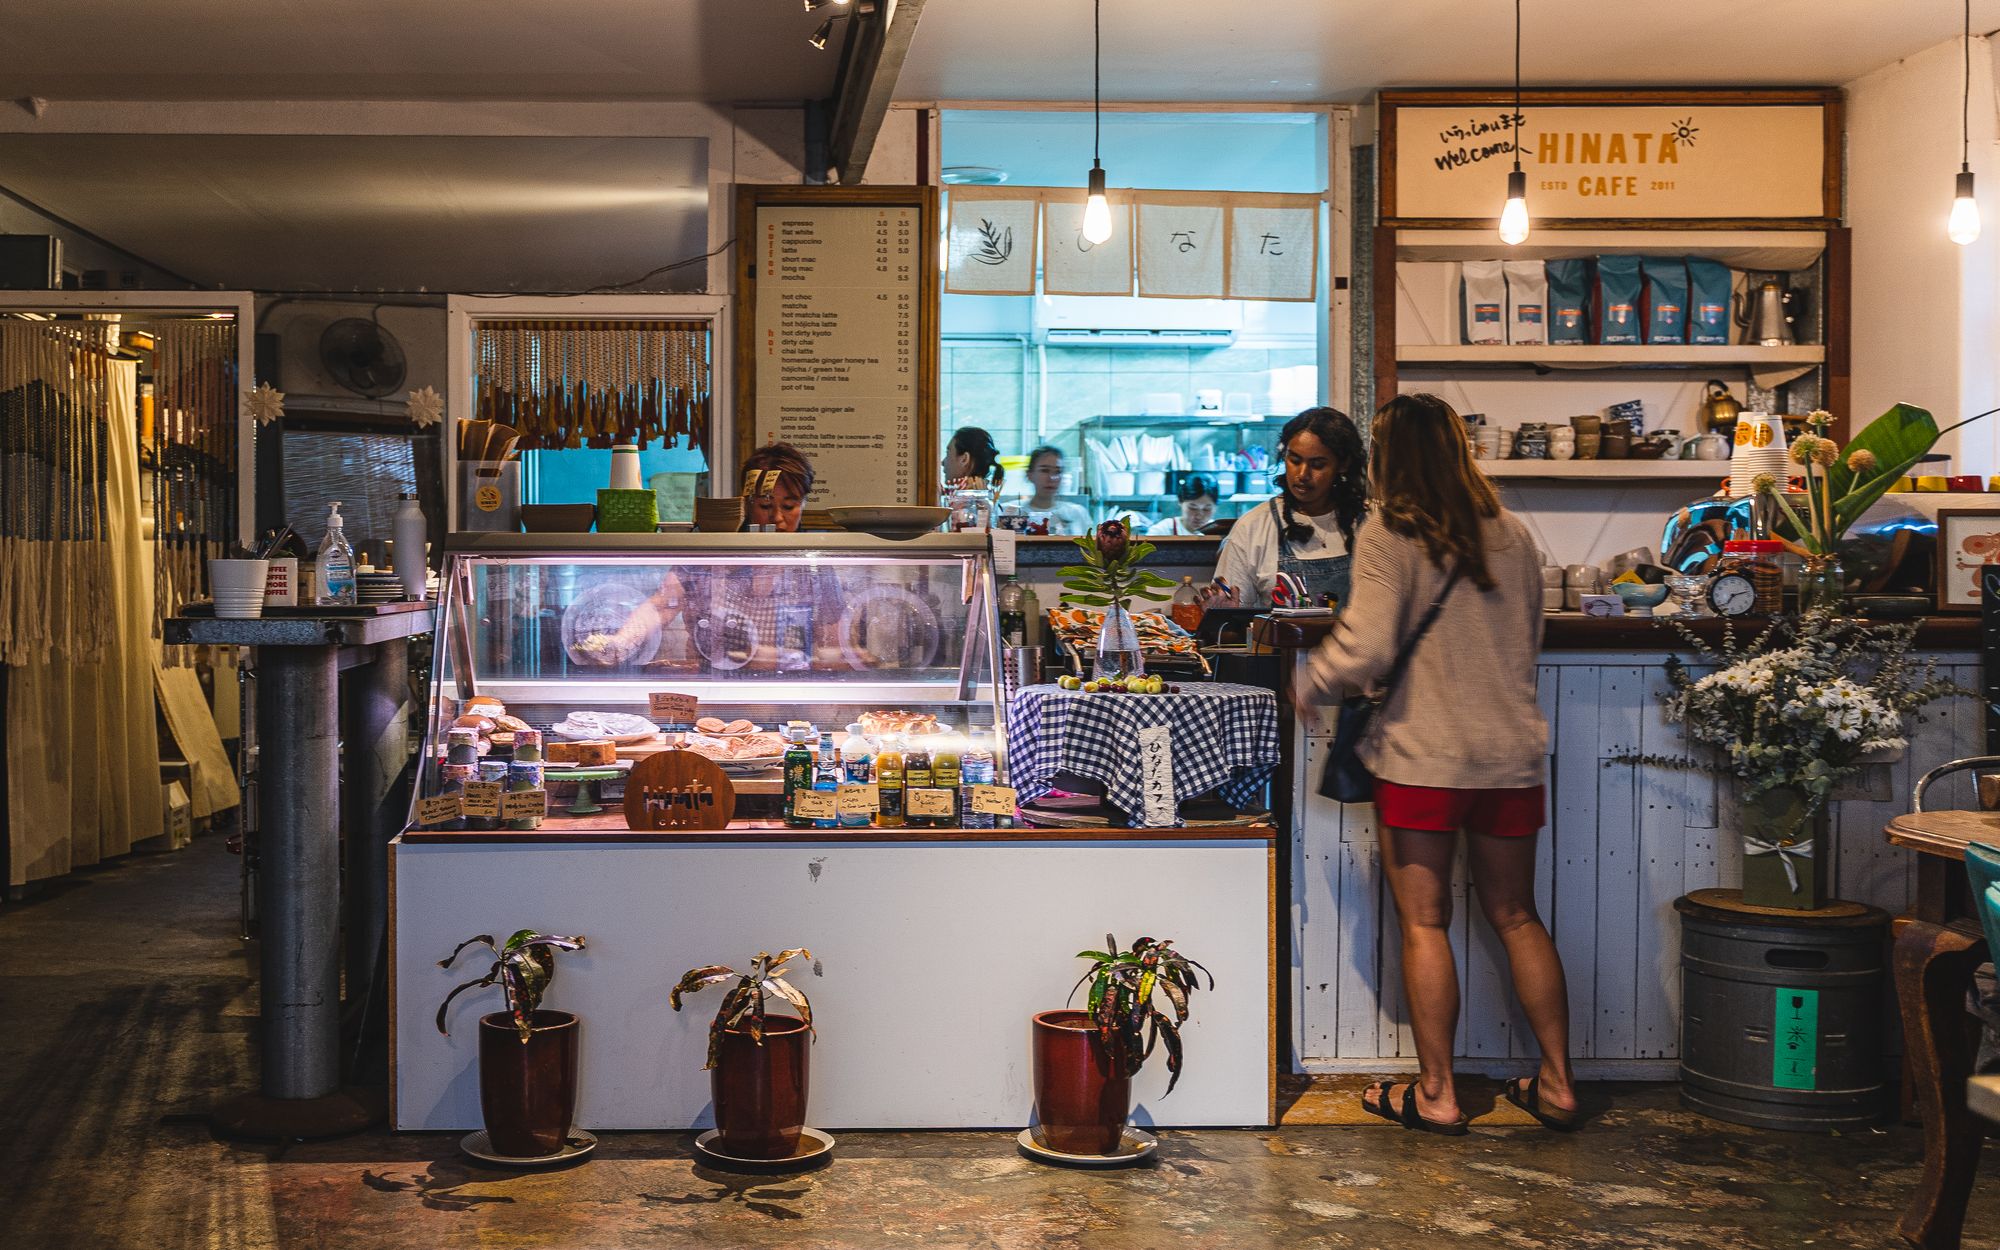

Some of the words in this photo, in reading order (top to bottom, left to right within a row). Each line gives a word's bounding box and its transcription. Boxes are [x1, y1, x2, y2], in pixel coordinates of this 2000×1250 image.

[1538, 132, 1679, 164] HINATA
[1541, 181, 1568, 190] ESTD
[1578, 176, 1637, 197] CAFE
[1651, 181, 1675, 190] 2011
[1170, 230, 1196, 253] な
[1260, 232, 1284, 255] た
[781, 265, 797, 273] long
[781, 293, 794, 301] hot
[794, 293, 813, 301] choc
[876, 293, 888, 301] 4.5
[897, 293, 910, 301] 5.0
[781, 302, 808, 310] matcha
[781, 311, 794, 319] hot
[794, 311, 821, 319] matcha
[822, 311, 838, 319] latte
[897, 311, 910, 319] 7.5
[781, 320, 794, 328] hot
[821, 320, 837, 328] latte
[781, 329, 794, 337] hot
[794, 329, 811, 338] dirty
[812, 330, 833, 338] kyoto
[781, 338, 798, 347] dirty
[798, 338, 814, 346] chai
[780, 347, 797, 355] chai
[798, 347, 814, 355] latte
[844, 357, 866, 365] honey
[812, 367, 833, 375] green
[897, 365, 909, 373] 4.5
[781, 384, 794, 392] pot
[794, 383, 802, 391] of
